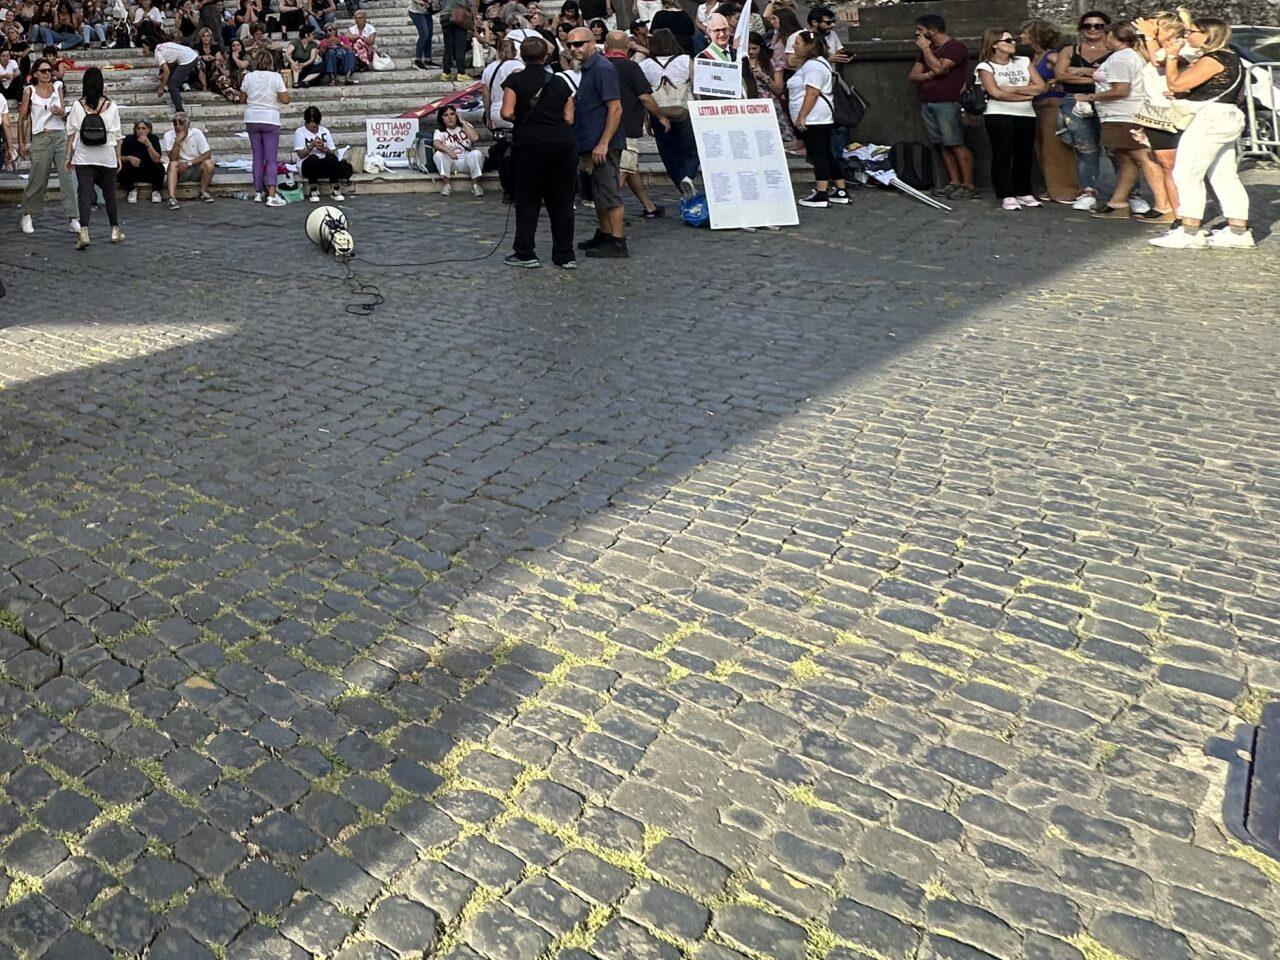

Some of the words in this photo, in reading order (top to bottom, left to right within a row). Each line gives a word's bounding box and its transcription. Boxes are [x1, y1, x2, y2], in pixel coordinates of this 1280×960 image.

[1009, 75, 1027, 85] LOVE
[698, 105, 719, 116] LETTERA
[720, 105, 739, 115] APERTA
[740, 105, 746, 114] AI
[746, 103, 770, 114] GENITORI
[371, 122, 412, 131] LOTTIAMO
